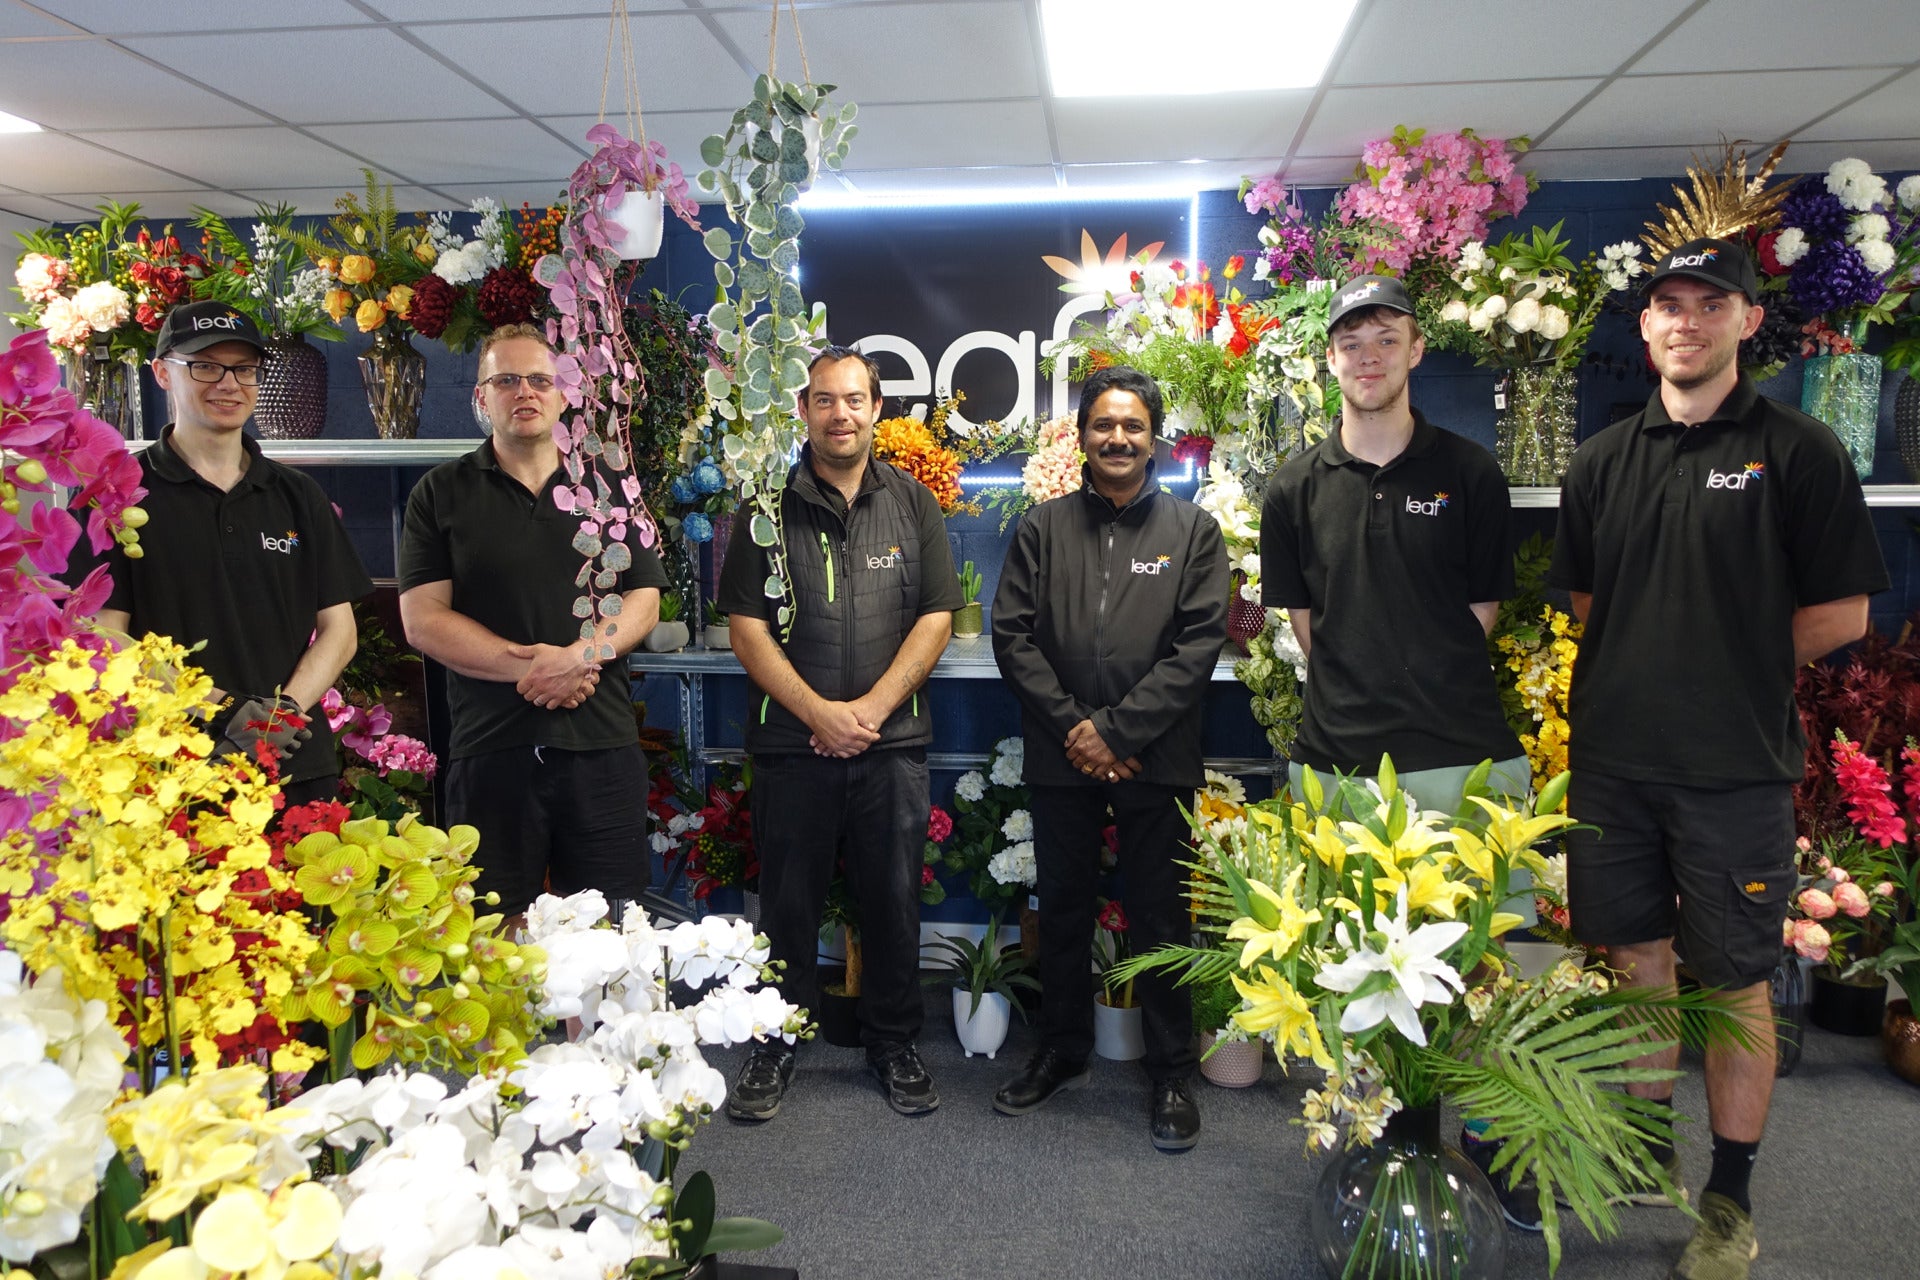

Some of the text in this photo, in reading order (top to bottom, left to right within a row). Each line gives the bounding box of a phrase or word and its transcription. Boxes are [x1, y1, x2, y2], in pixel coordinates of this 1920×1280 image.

[1669, 253, 1709, 269] leaf
[193, 316, 236, 331] leaf
[1706, 469, 1753, 490] leaf
[1405, 495, 1442, 516] leaf
[261, 532, 292, 554] leaf
[866, 553, 896, 569] leaf
[1131, 558, 1163, 575] leaf
[1745, 882, 1766, 893] site
